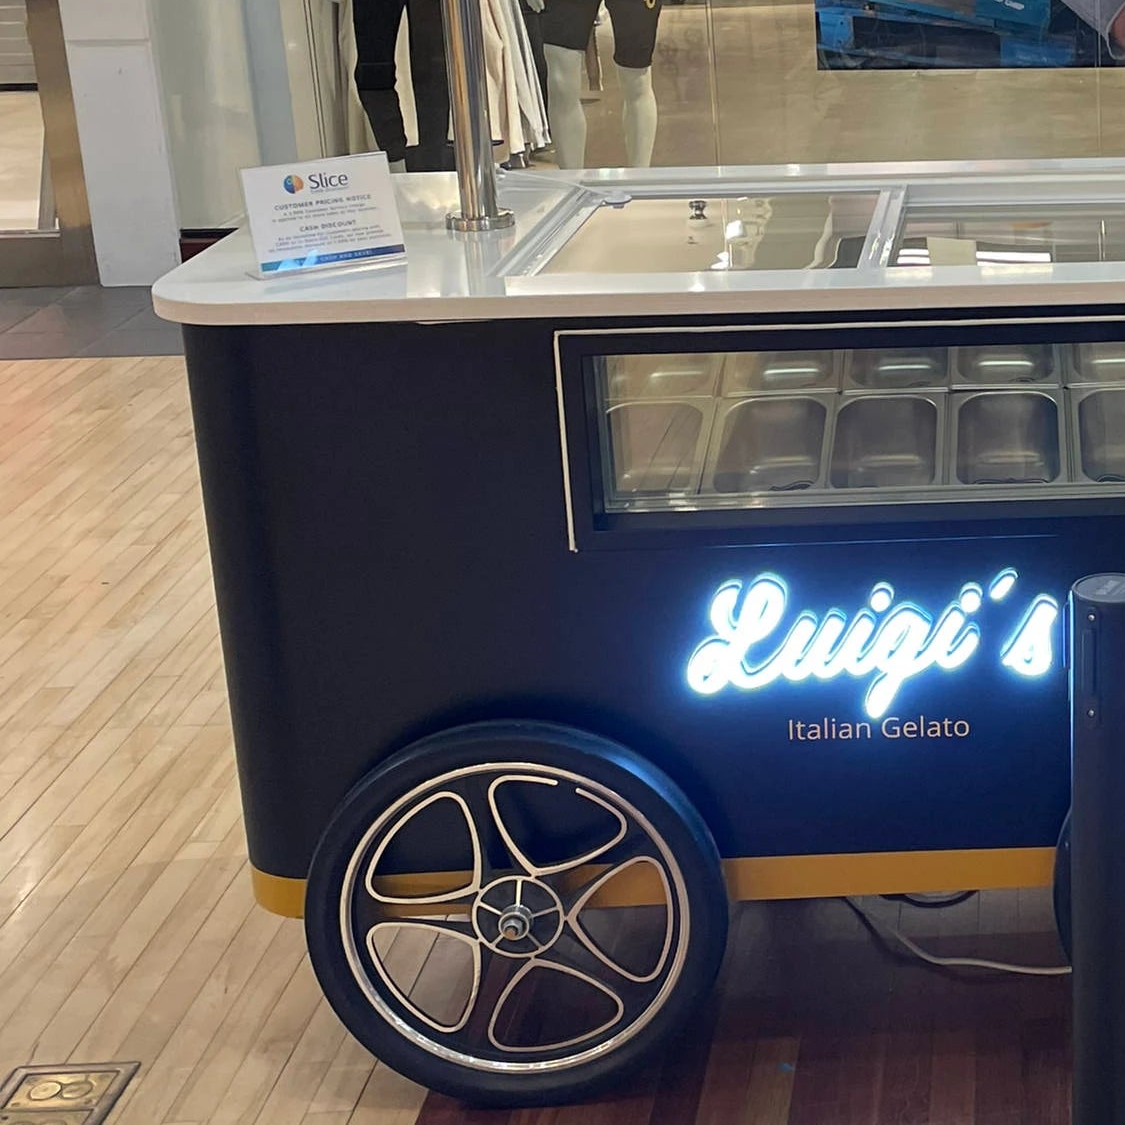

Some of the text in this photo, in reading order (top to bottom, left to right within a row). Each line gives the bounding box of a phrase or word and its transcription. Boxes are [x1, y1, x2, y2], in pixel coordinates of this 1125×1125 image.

[308, 172, 349, 190] Slice
[274, 201, 314, 211] CUSTOMER
[315, 197, 345, 207] PRICING
[321, 219, 357, 230] DISCOUNT
[686, 567, 1059, 719] Luigi's
[788, 716, 970, 740] Italian Gelato
